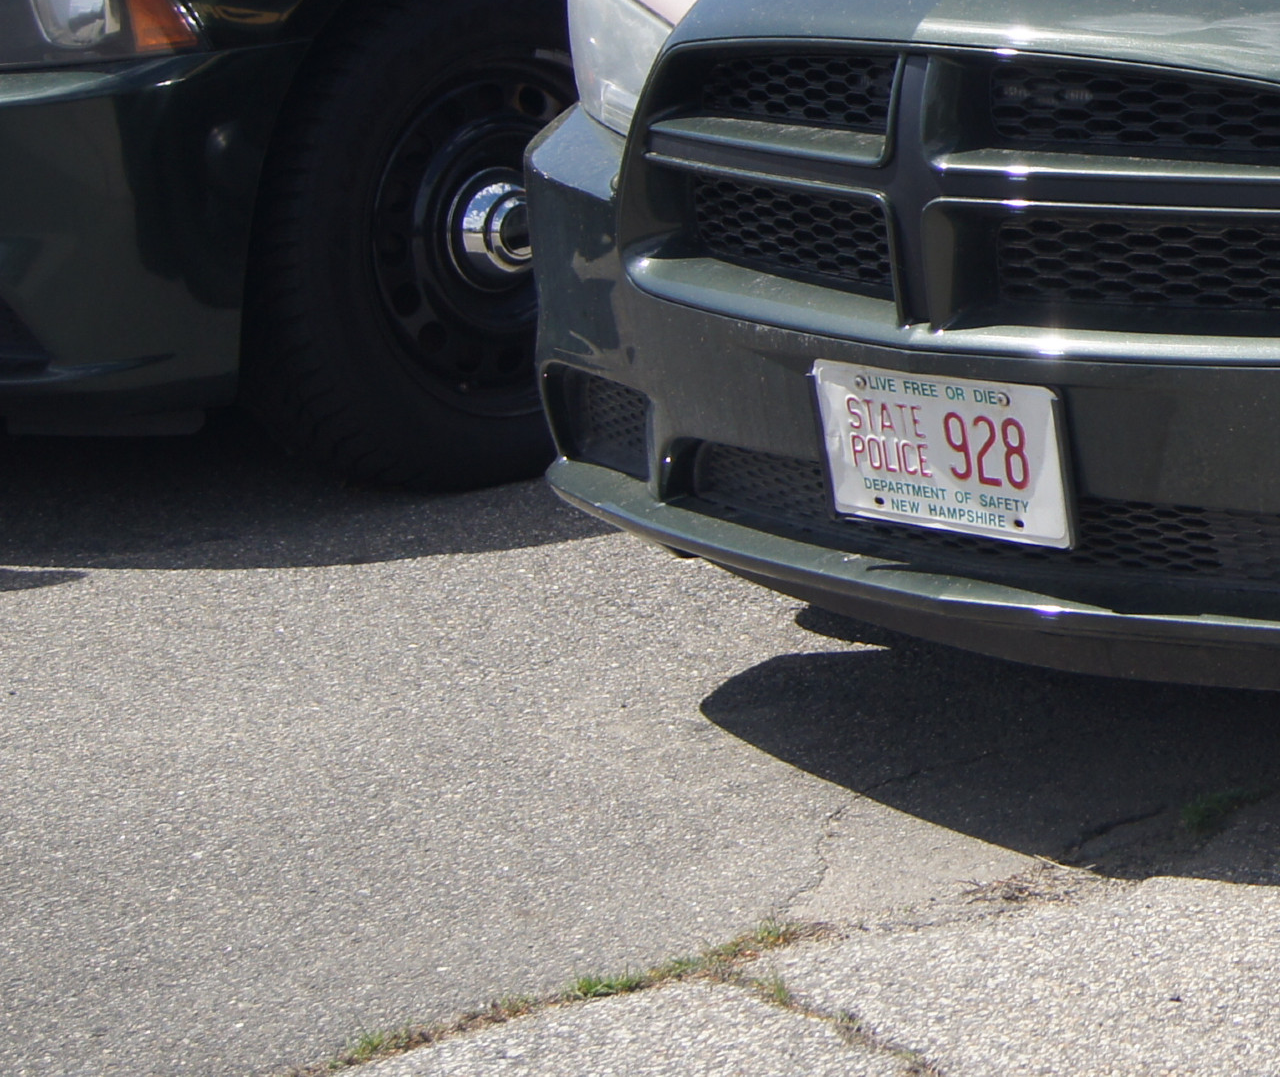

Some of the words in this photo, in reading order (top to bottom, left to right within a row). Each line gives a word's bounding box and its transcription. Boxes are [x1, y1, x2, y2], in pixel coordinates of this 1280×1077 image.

[869, 376, 897, 393] LIVE
[903, 380, 939, 398] FREE
[945, 386, 965, 401] OR
[973, 389, 998, 405] DIE
[846, 396, 926, 439] STATE
[851, 433, 933, 478] POLICE
[943, 411, 1031, 491] 928
[864, 477, 947, 501] DEPARTMENT
[955, 490, 972, 504] OF
[980, 494, 1030, 514] SAFETY
[891, 499, 920, 515] NEW
[928, 503, 1007, 528] HAMPSHIRE
